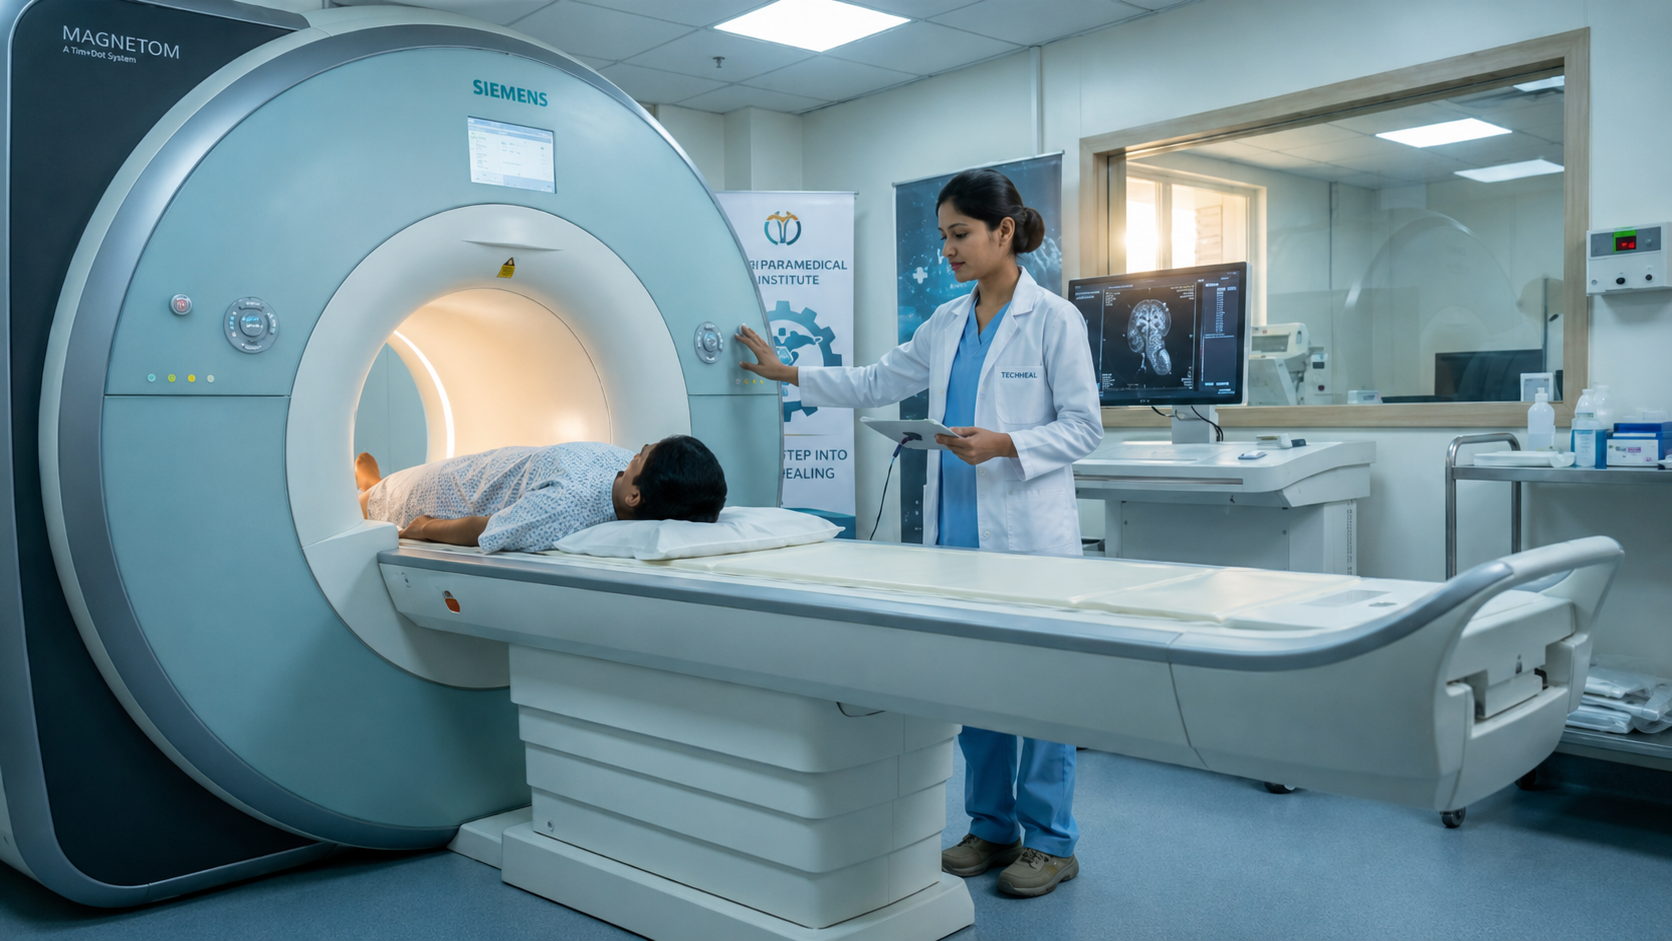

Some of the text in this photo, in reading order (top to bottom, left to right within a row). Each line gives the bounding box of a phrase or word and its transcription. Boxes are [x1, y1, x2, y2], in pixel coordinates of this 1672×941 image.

[63, 25, 180, 60] MAGNETOM
[63, 45, 70, 53] A
[107, 52, 137, 64] System
[473, 79, 548, 107] SIEMENS
[760, 260, 848, 270] PARAMEDICAL
[758, 275, 820, 285] INSTITUTE
[815, 449, 848, 461] INTO
